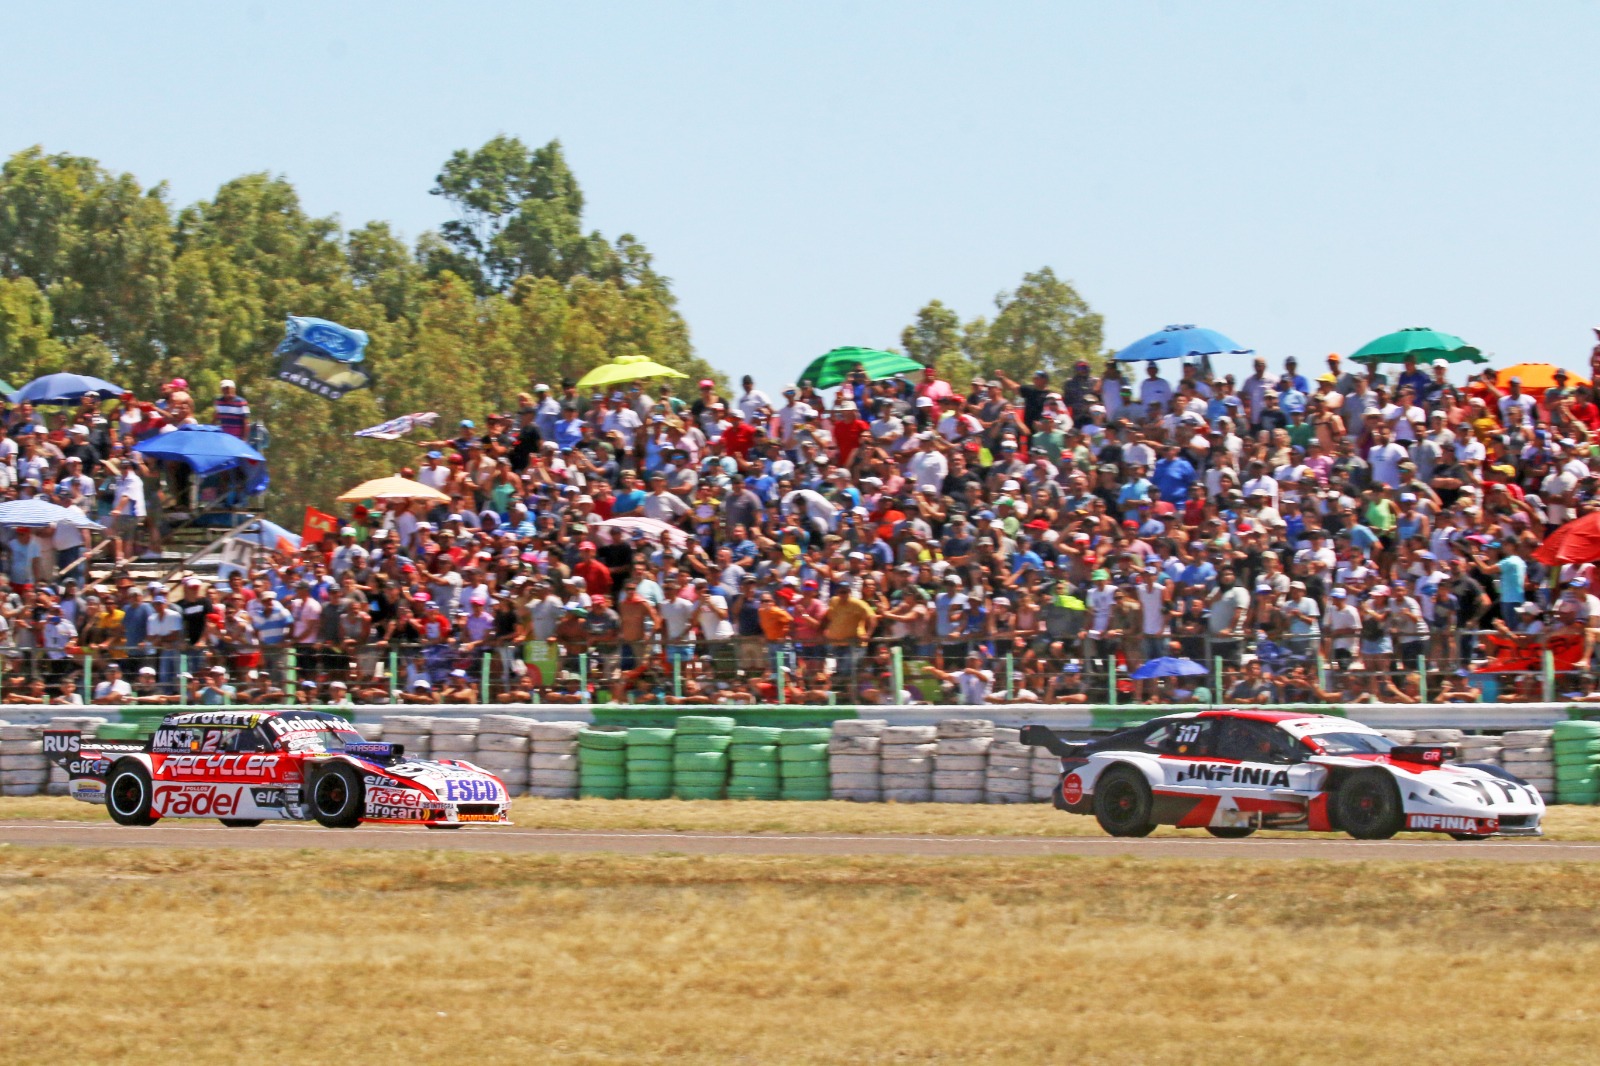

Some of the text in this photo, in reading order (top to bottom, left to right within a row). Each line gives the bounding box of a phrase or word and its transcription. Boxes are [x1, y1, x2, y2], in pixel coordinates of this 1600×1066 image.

[43, 735, 80, 753] RUS
[202, 730, 222, 752] 2
[69, 760, 93, 774] elf
[1187, 763, 1290, 787] INFINIA
[154, 785, 244, 816] Fadel
[367, 786, 422, 807] Fadel
[366, 802, 422, 819] Brocart
[1410, 815, 1478, 831] INFINIA
